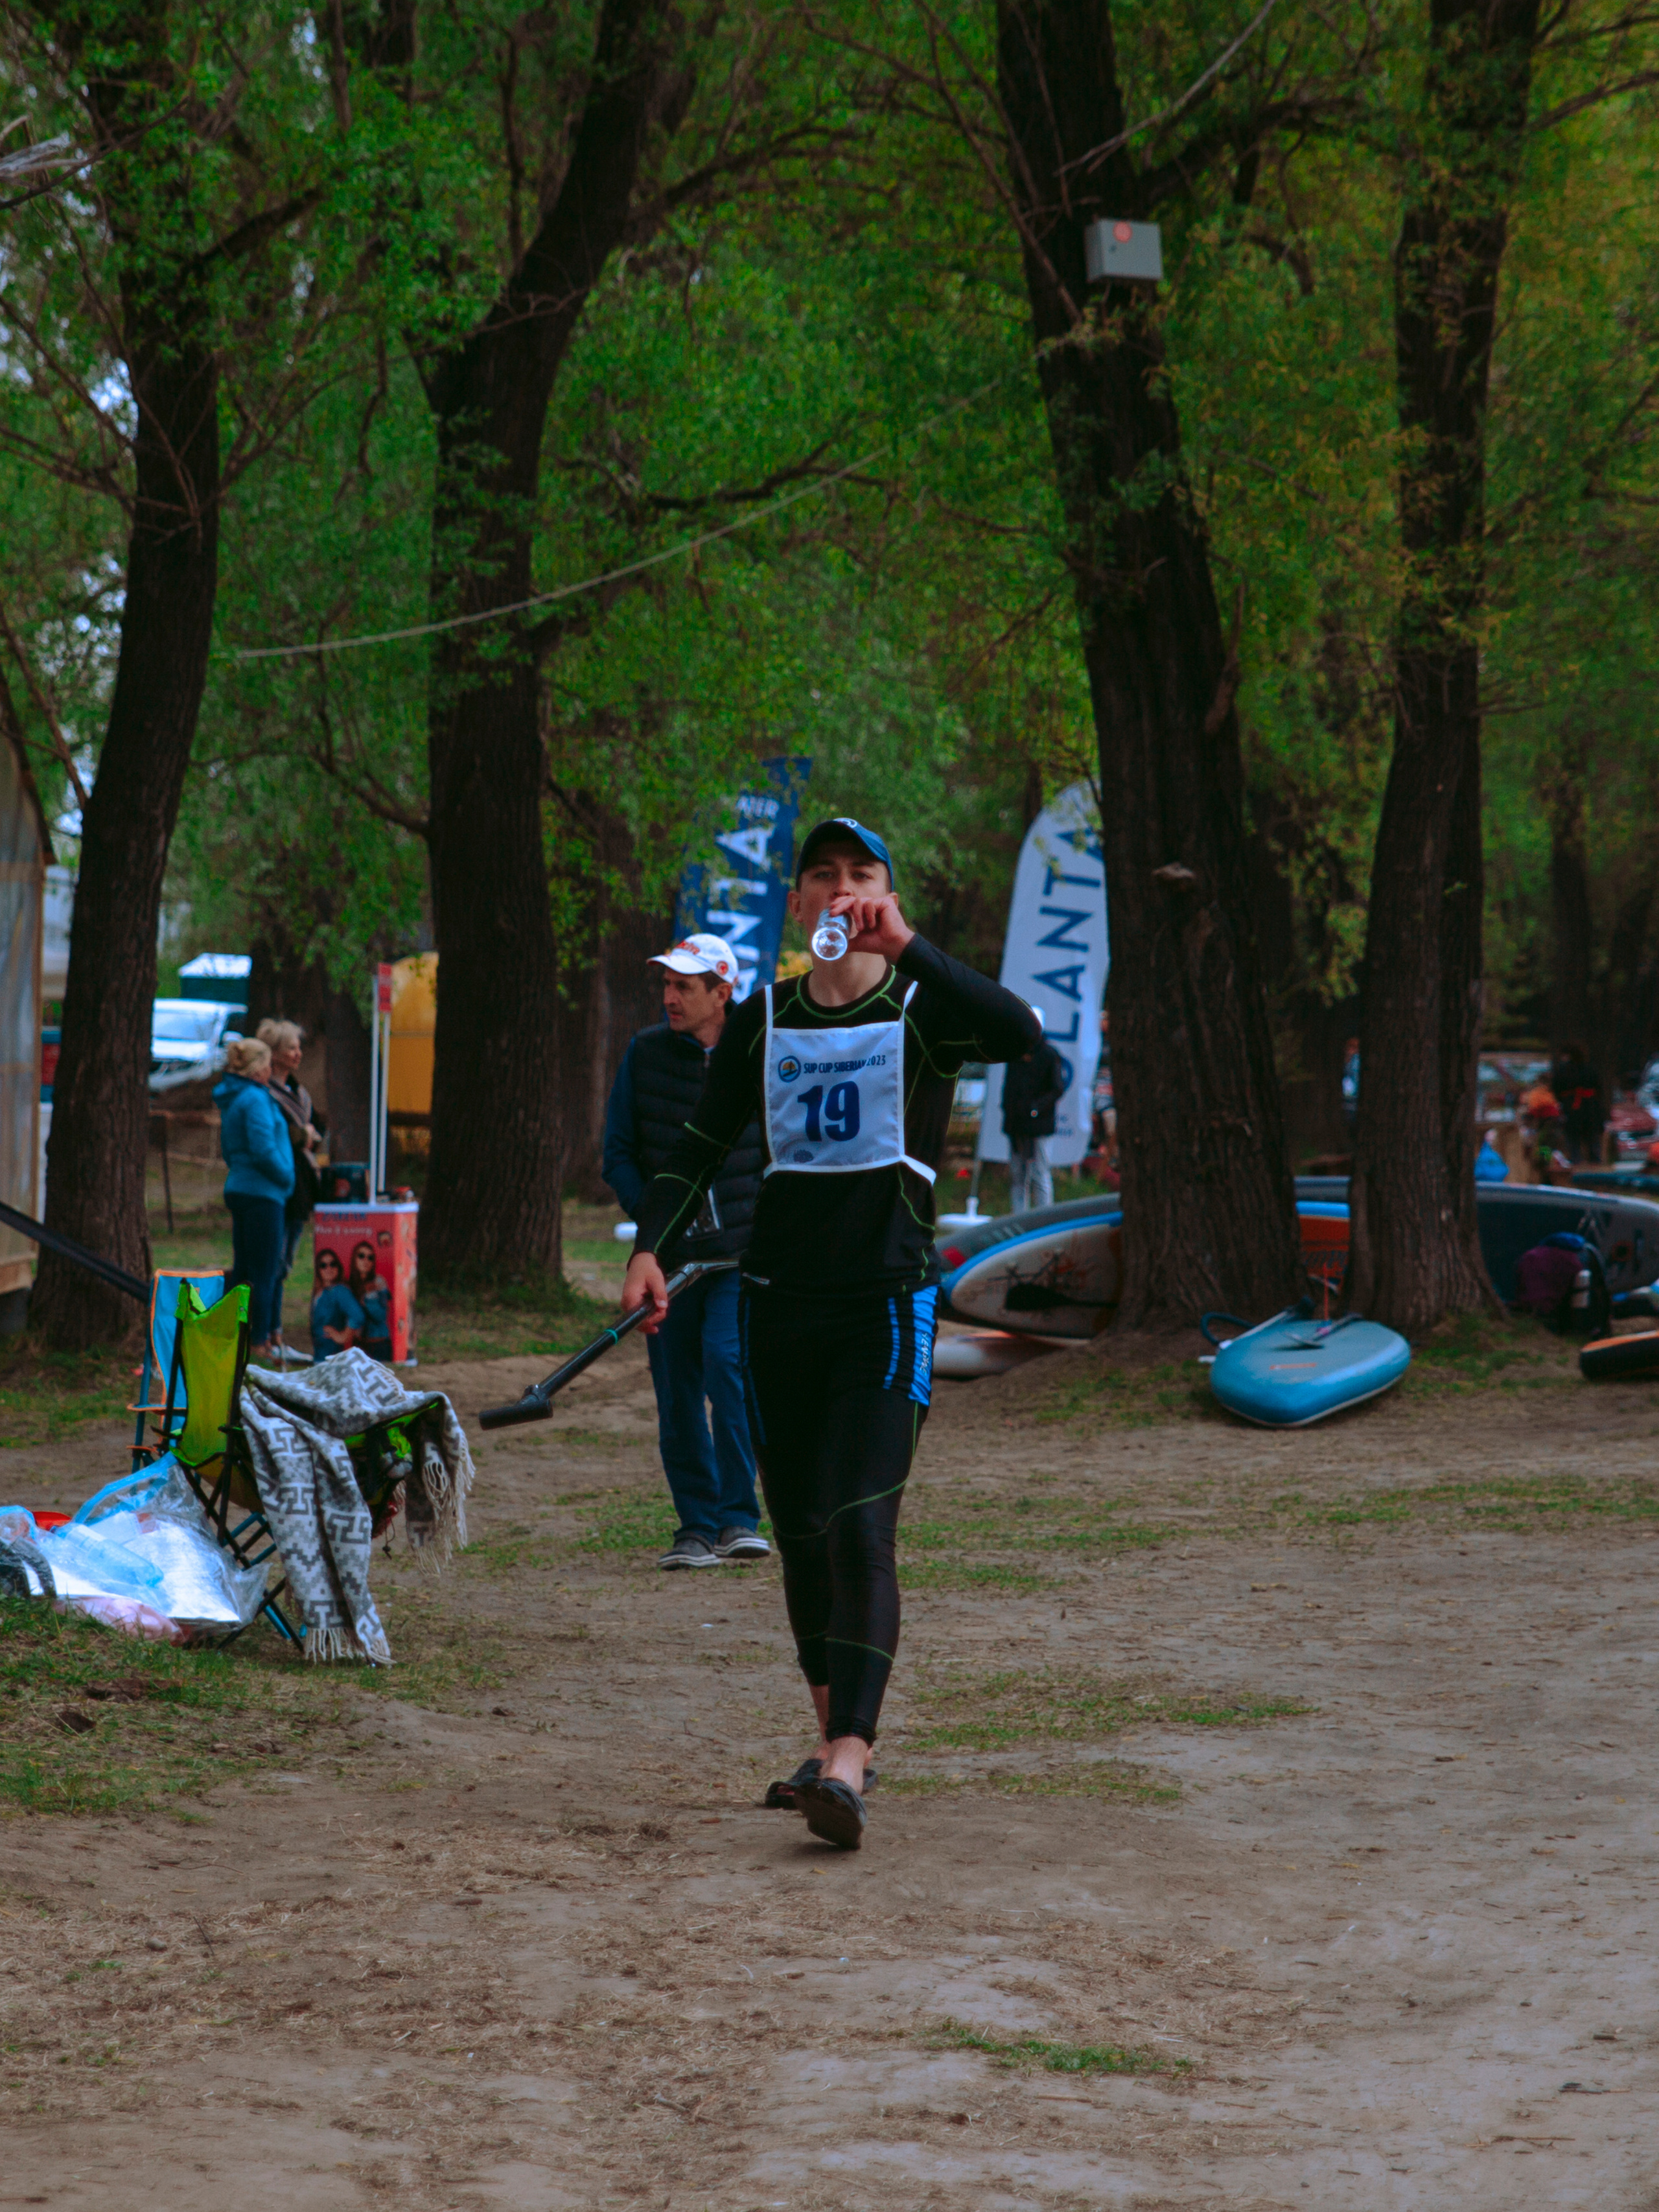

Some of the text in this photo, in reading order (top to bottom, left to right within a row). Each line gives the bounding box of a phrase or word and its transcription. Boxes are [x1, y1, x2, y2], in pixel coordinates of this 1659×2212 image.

[1031, 826, 1103, 1093] LANTA
[804, 1062, 817, 1073] SUP
[818, 1062, 833, 1073] CUP
[797, 1080, 860, 1142] 19
